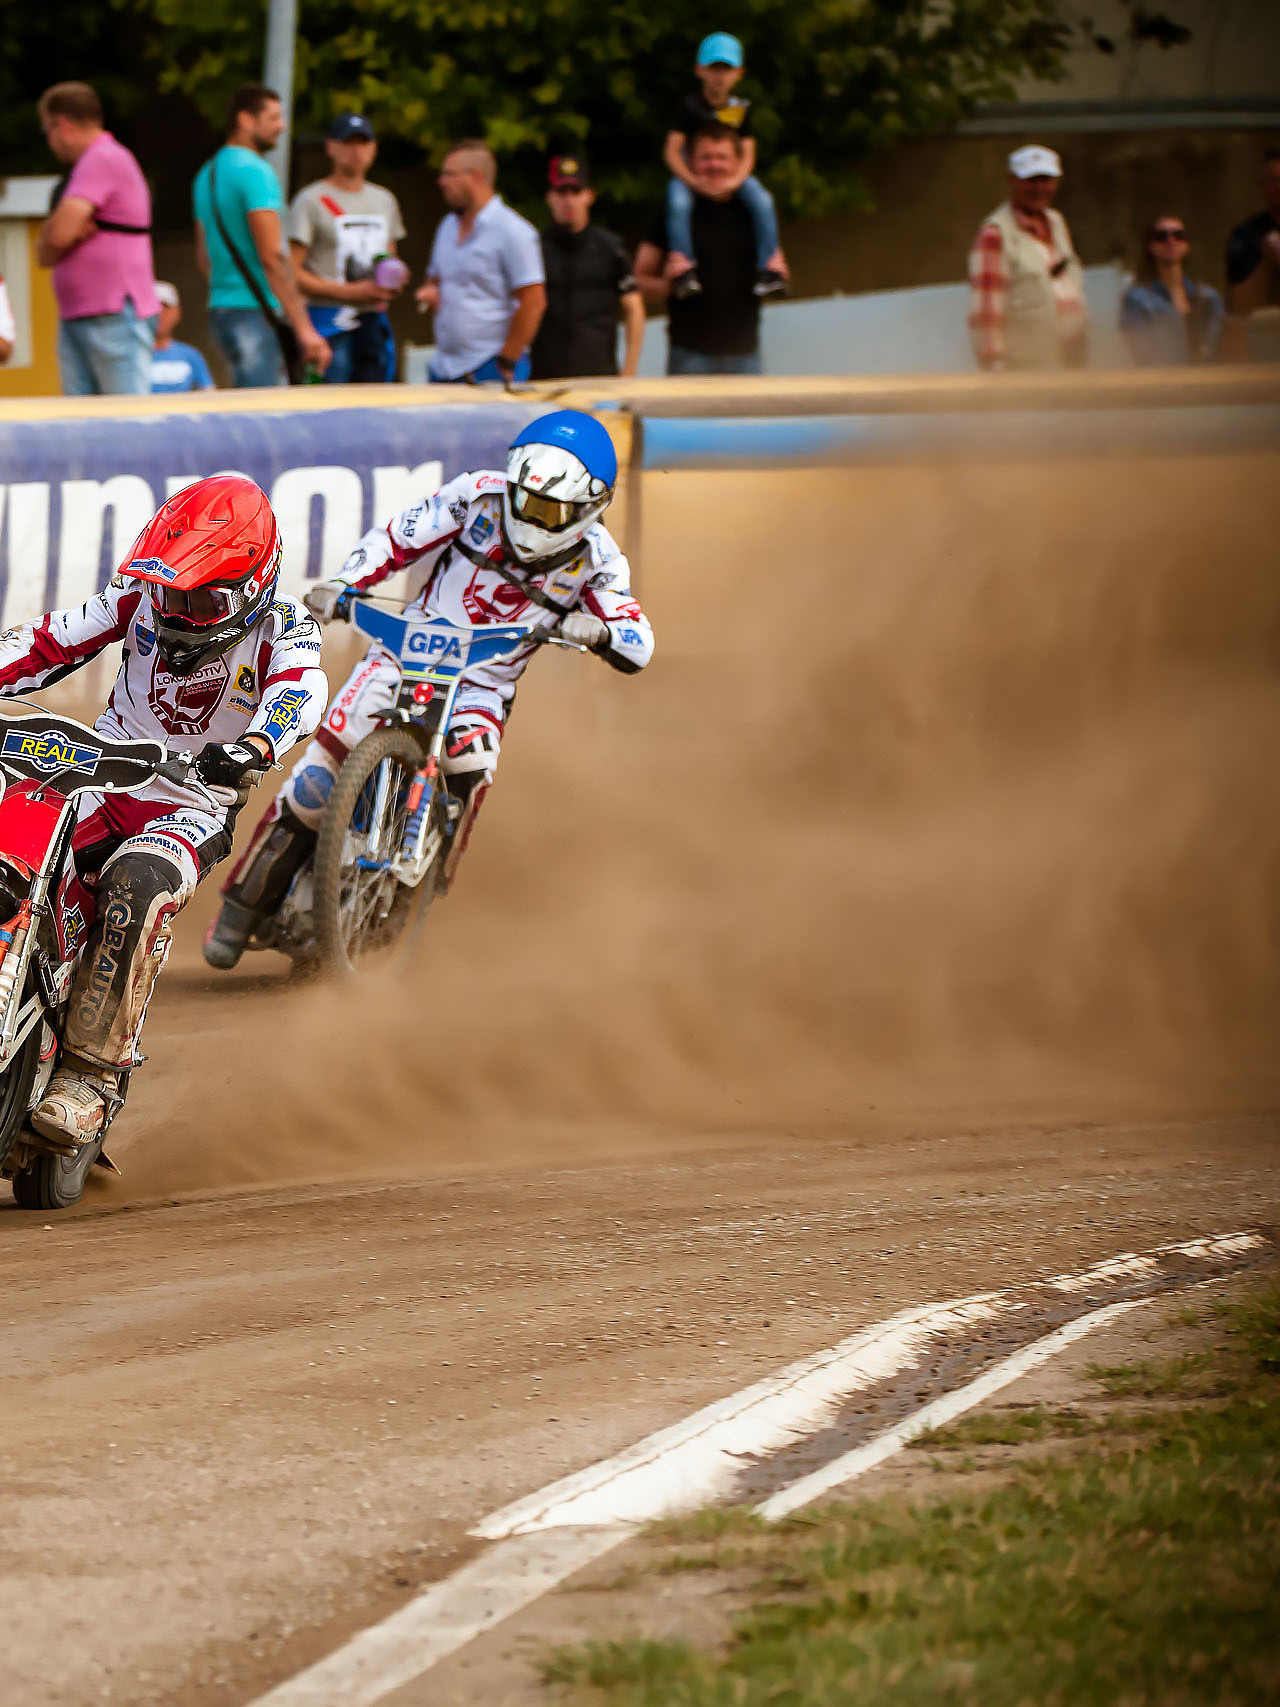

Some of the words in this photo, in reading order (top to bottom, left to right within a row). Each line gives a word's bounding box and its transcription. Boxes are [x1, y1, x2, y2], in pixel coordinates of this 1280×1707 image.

[409, 632, 461, 658] GPA
[156, 665, 222, 686] LOKOMOTIV
[272, 693, 302, 731] REALL
[20, 738, 79, 764] REALL
